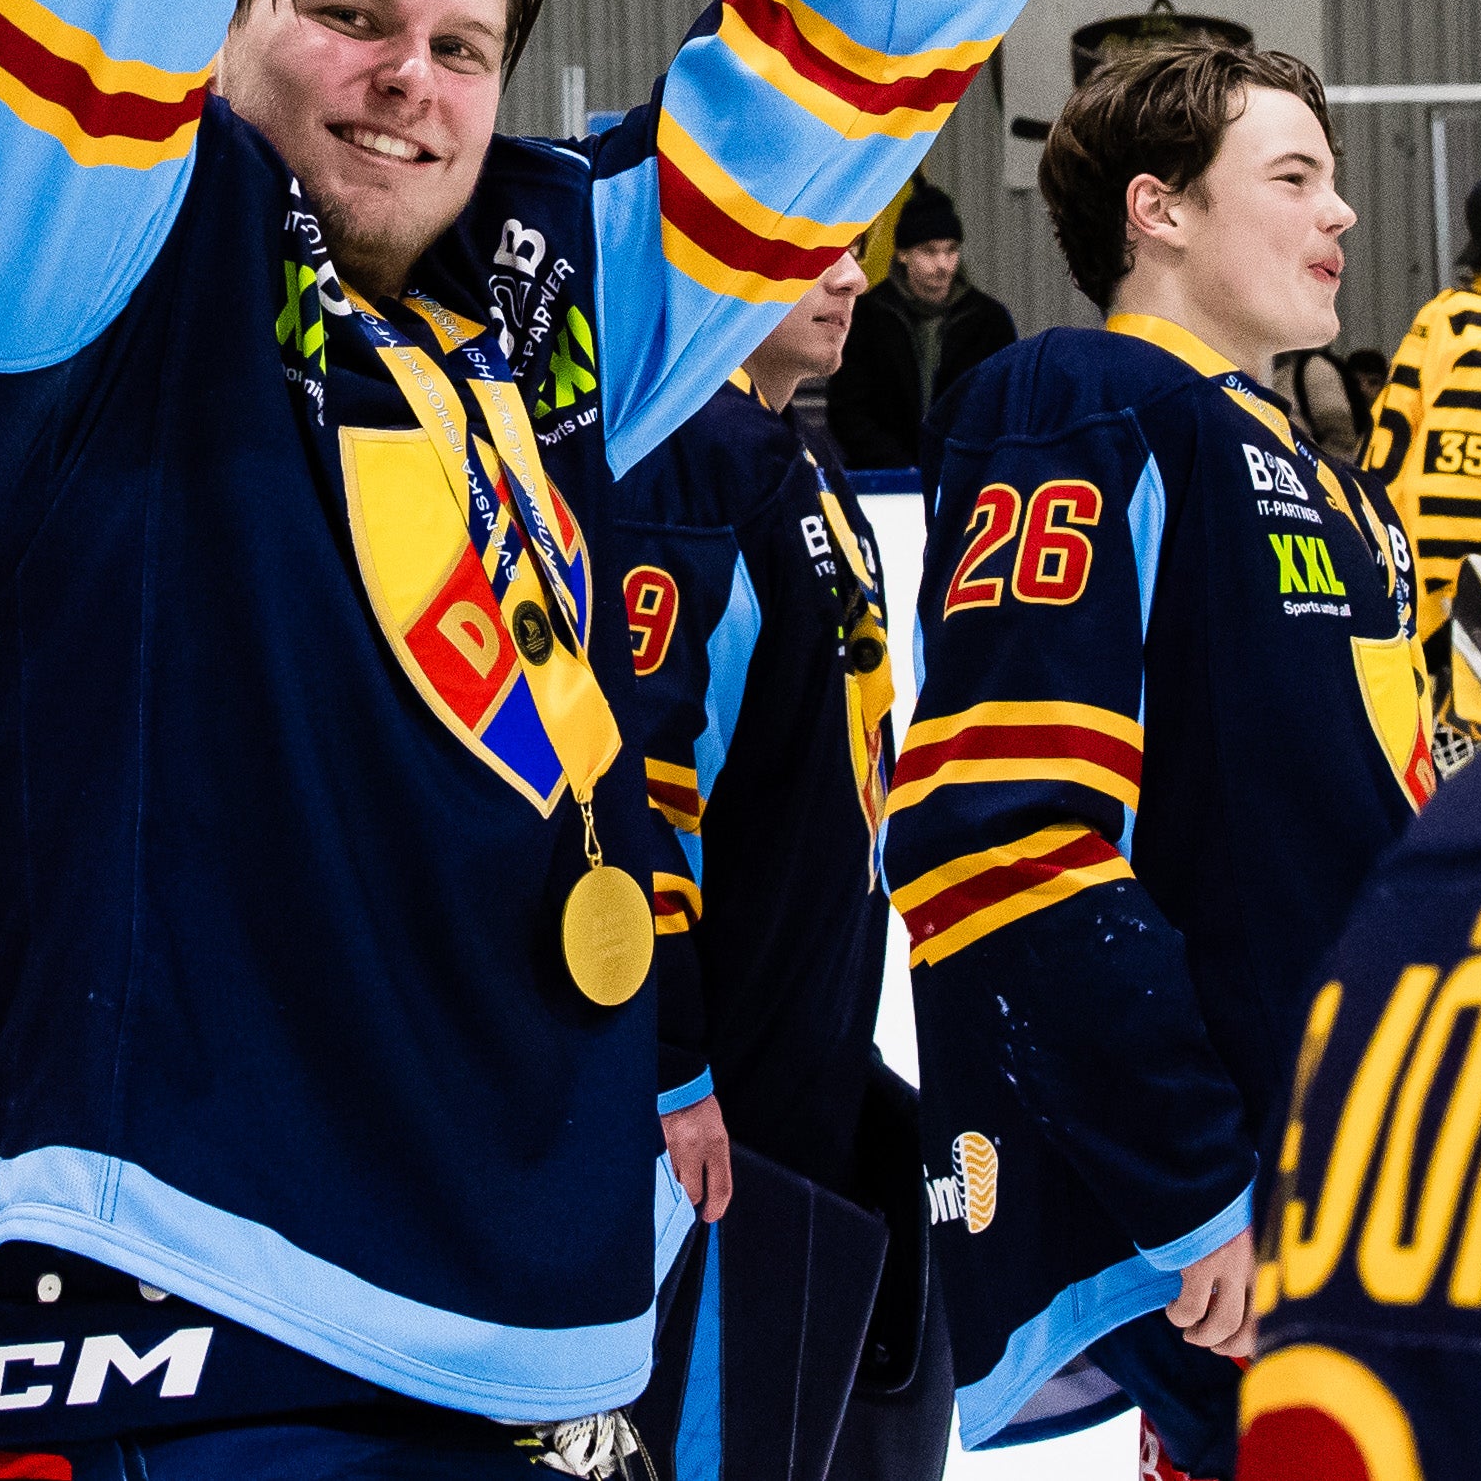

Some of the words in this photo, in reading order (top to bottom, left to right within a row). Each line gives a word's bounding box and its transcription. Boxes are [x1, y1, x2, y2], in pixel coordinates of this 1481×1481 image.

[1256, 500, 1323, 525] IT-PARTNER
[943, 479, 1103, 622] 26
[1268, 534, 1346, 598] XXL
[1283, 600, 1321, 617] Sports
